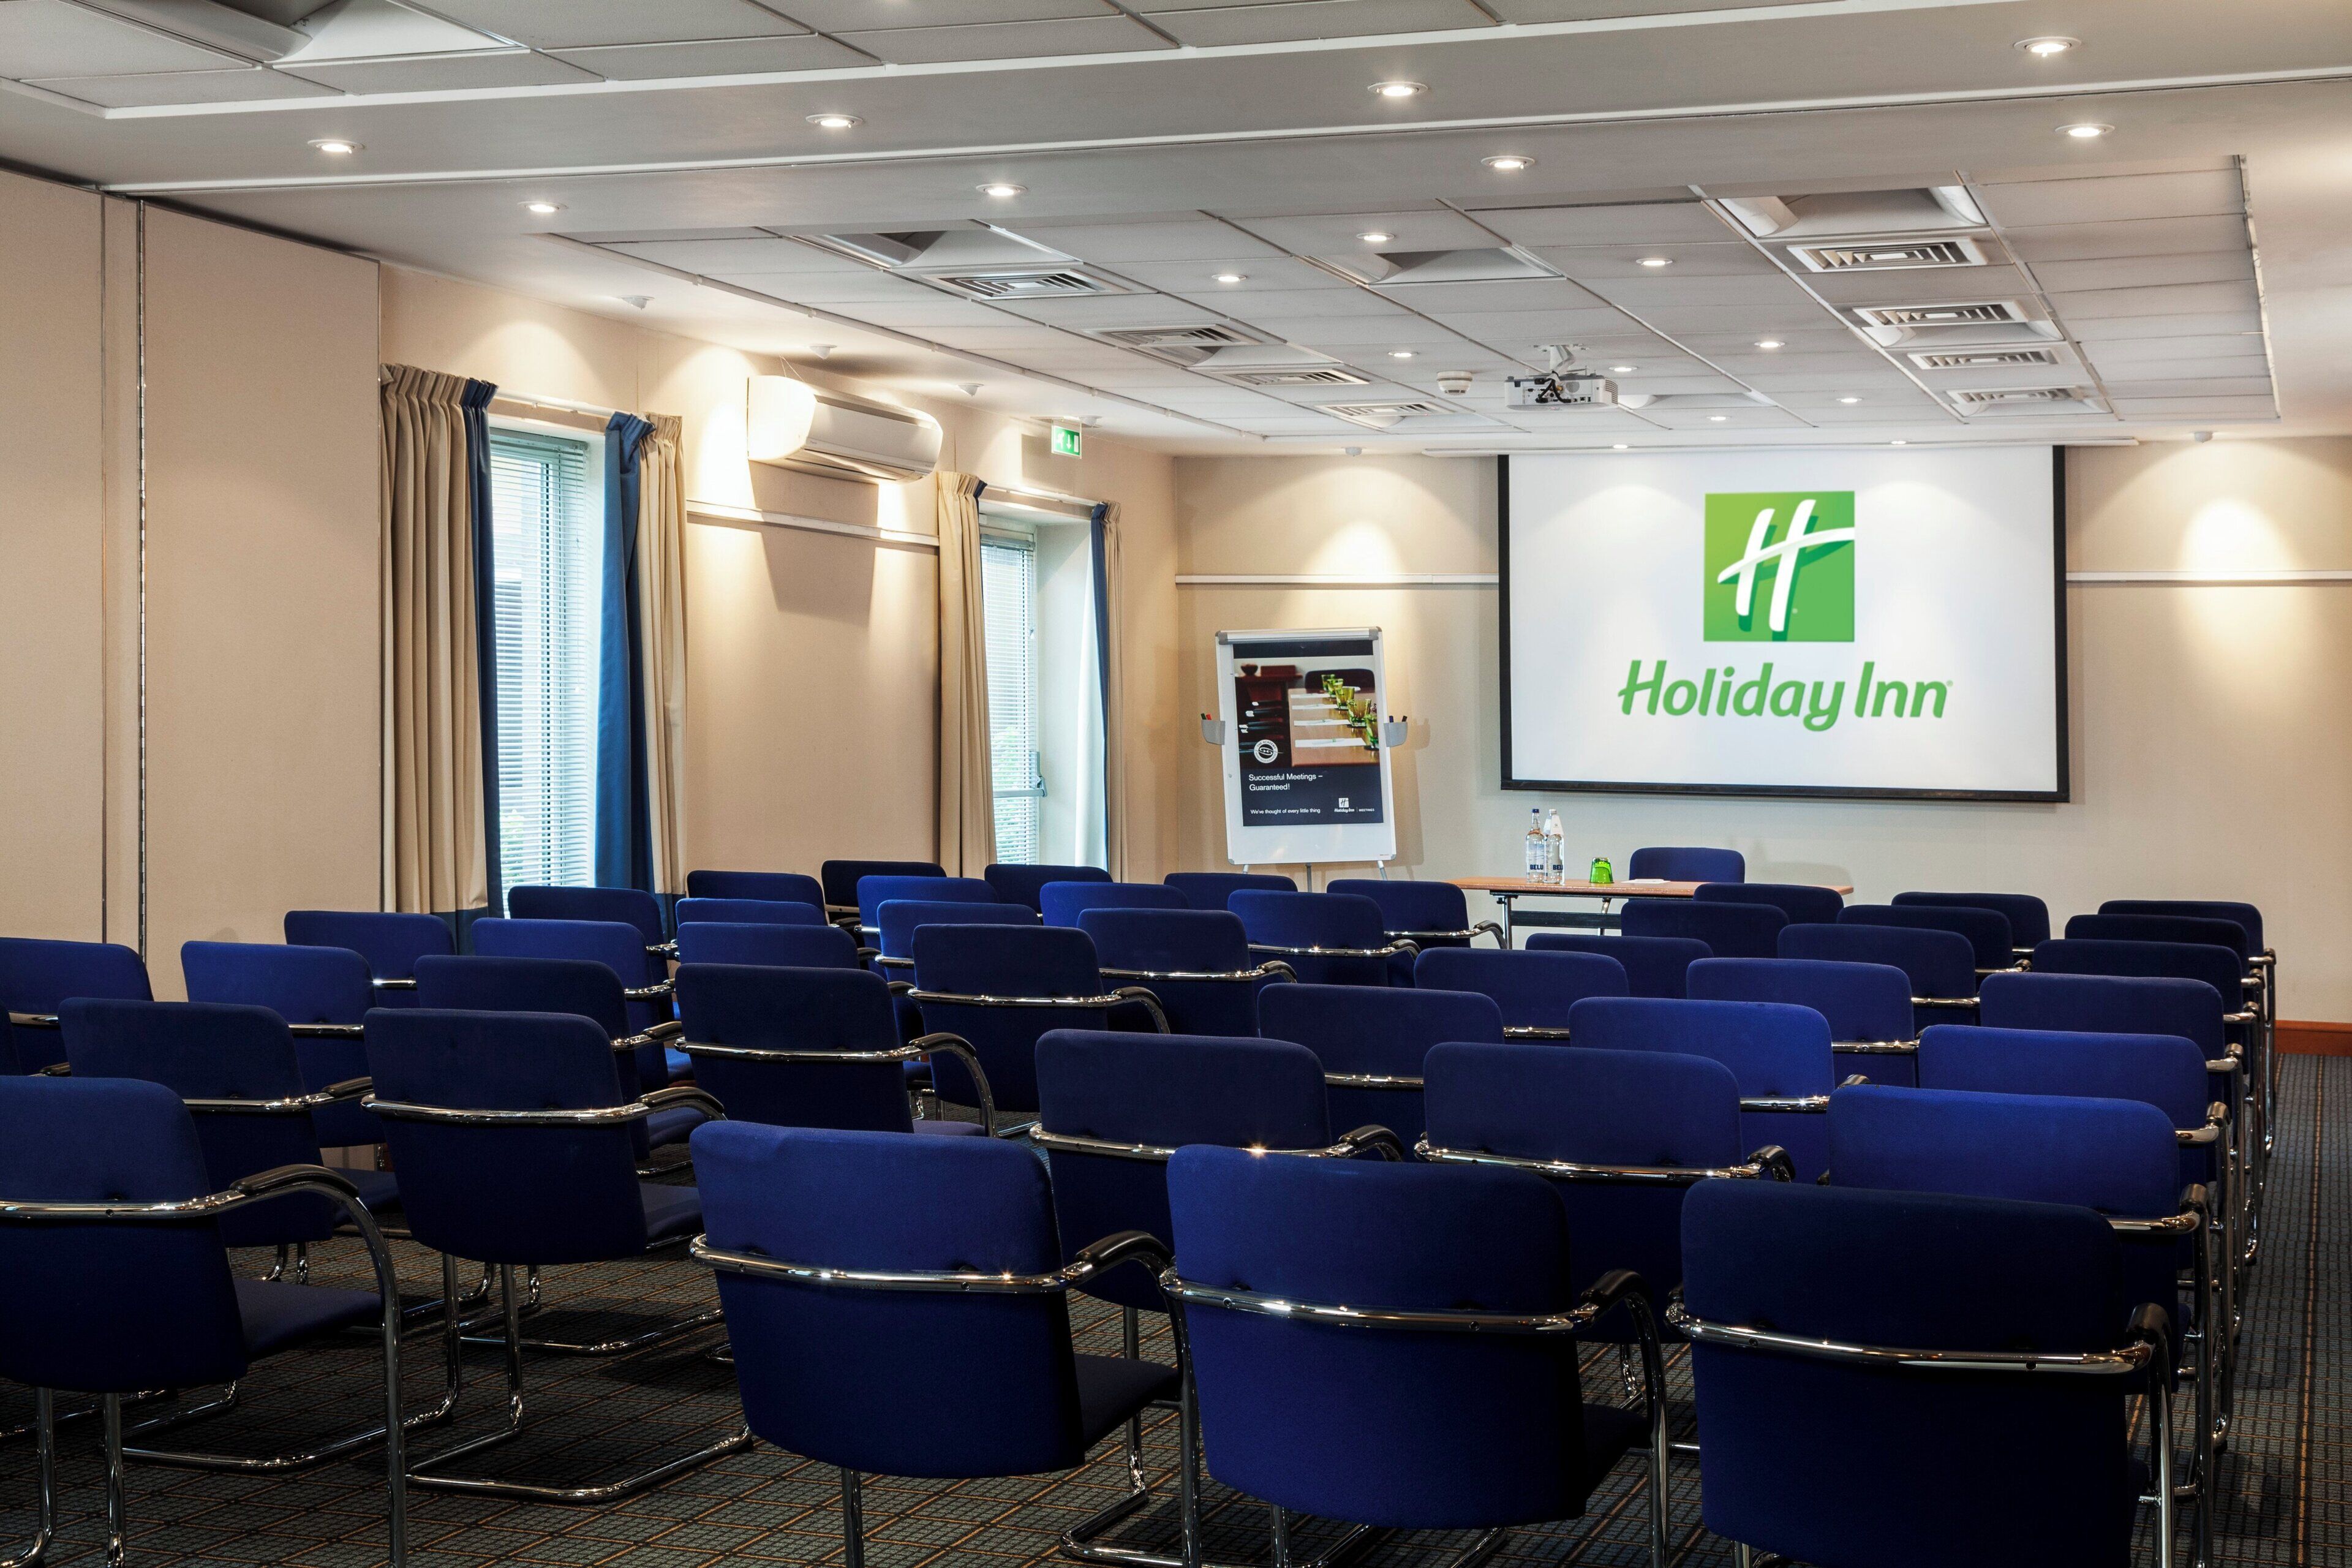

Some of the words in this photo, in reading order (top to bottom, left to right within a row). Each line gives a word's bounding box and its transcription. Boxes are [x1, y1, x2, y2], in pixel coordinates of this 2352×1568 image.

[1717, 499, 1855, 631] H
[1618, 660, 1845, 732] Holiday
[1854, 662, 1948, 718] Inn
